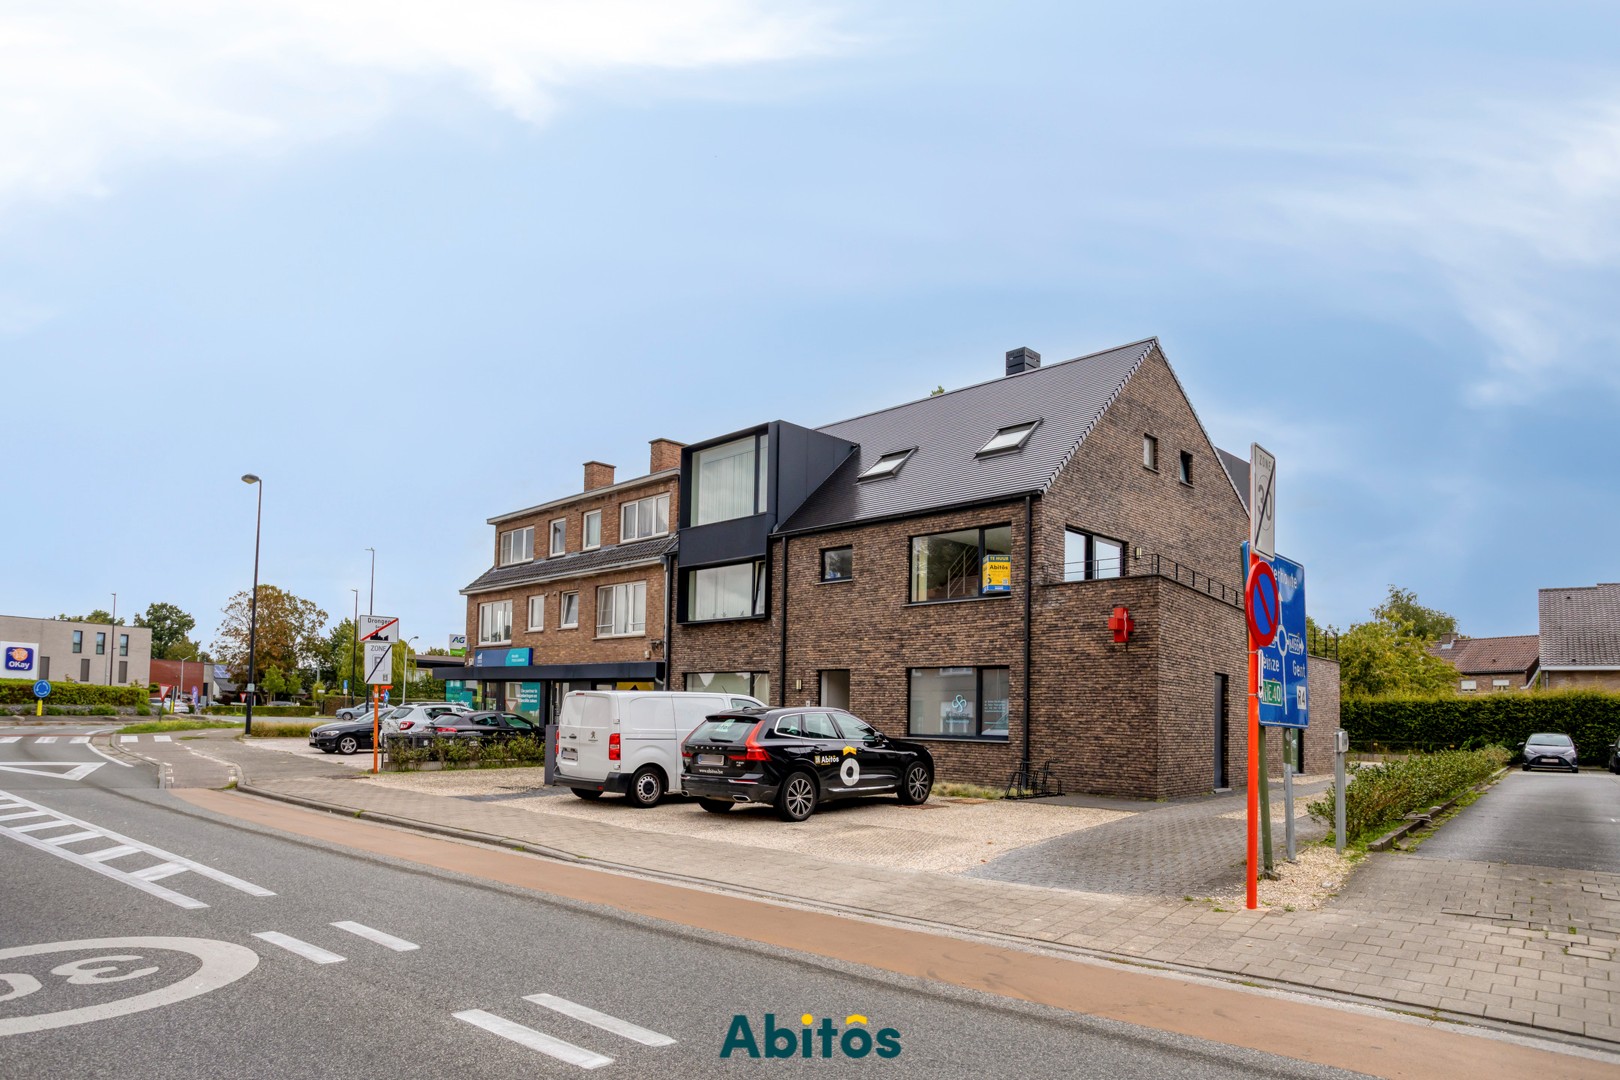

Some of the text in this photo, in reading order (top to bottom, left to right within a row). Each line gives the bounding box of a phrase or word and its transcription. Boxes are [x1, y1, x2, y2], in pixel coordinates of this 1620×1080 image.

[1259, 454, 1271, 472] ZONE
[1257, 484, 1272, 522] 30
[1272, 564, 1298, 589] erhoute
[452, 636, 466, 644] AG
[8, 660, 31, 670] OKay
[1263, 654, 1280, 673] einze
[1292, 659, 1306, 678] Gent
[1298, 688, 1306, 706] R4
